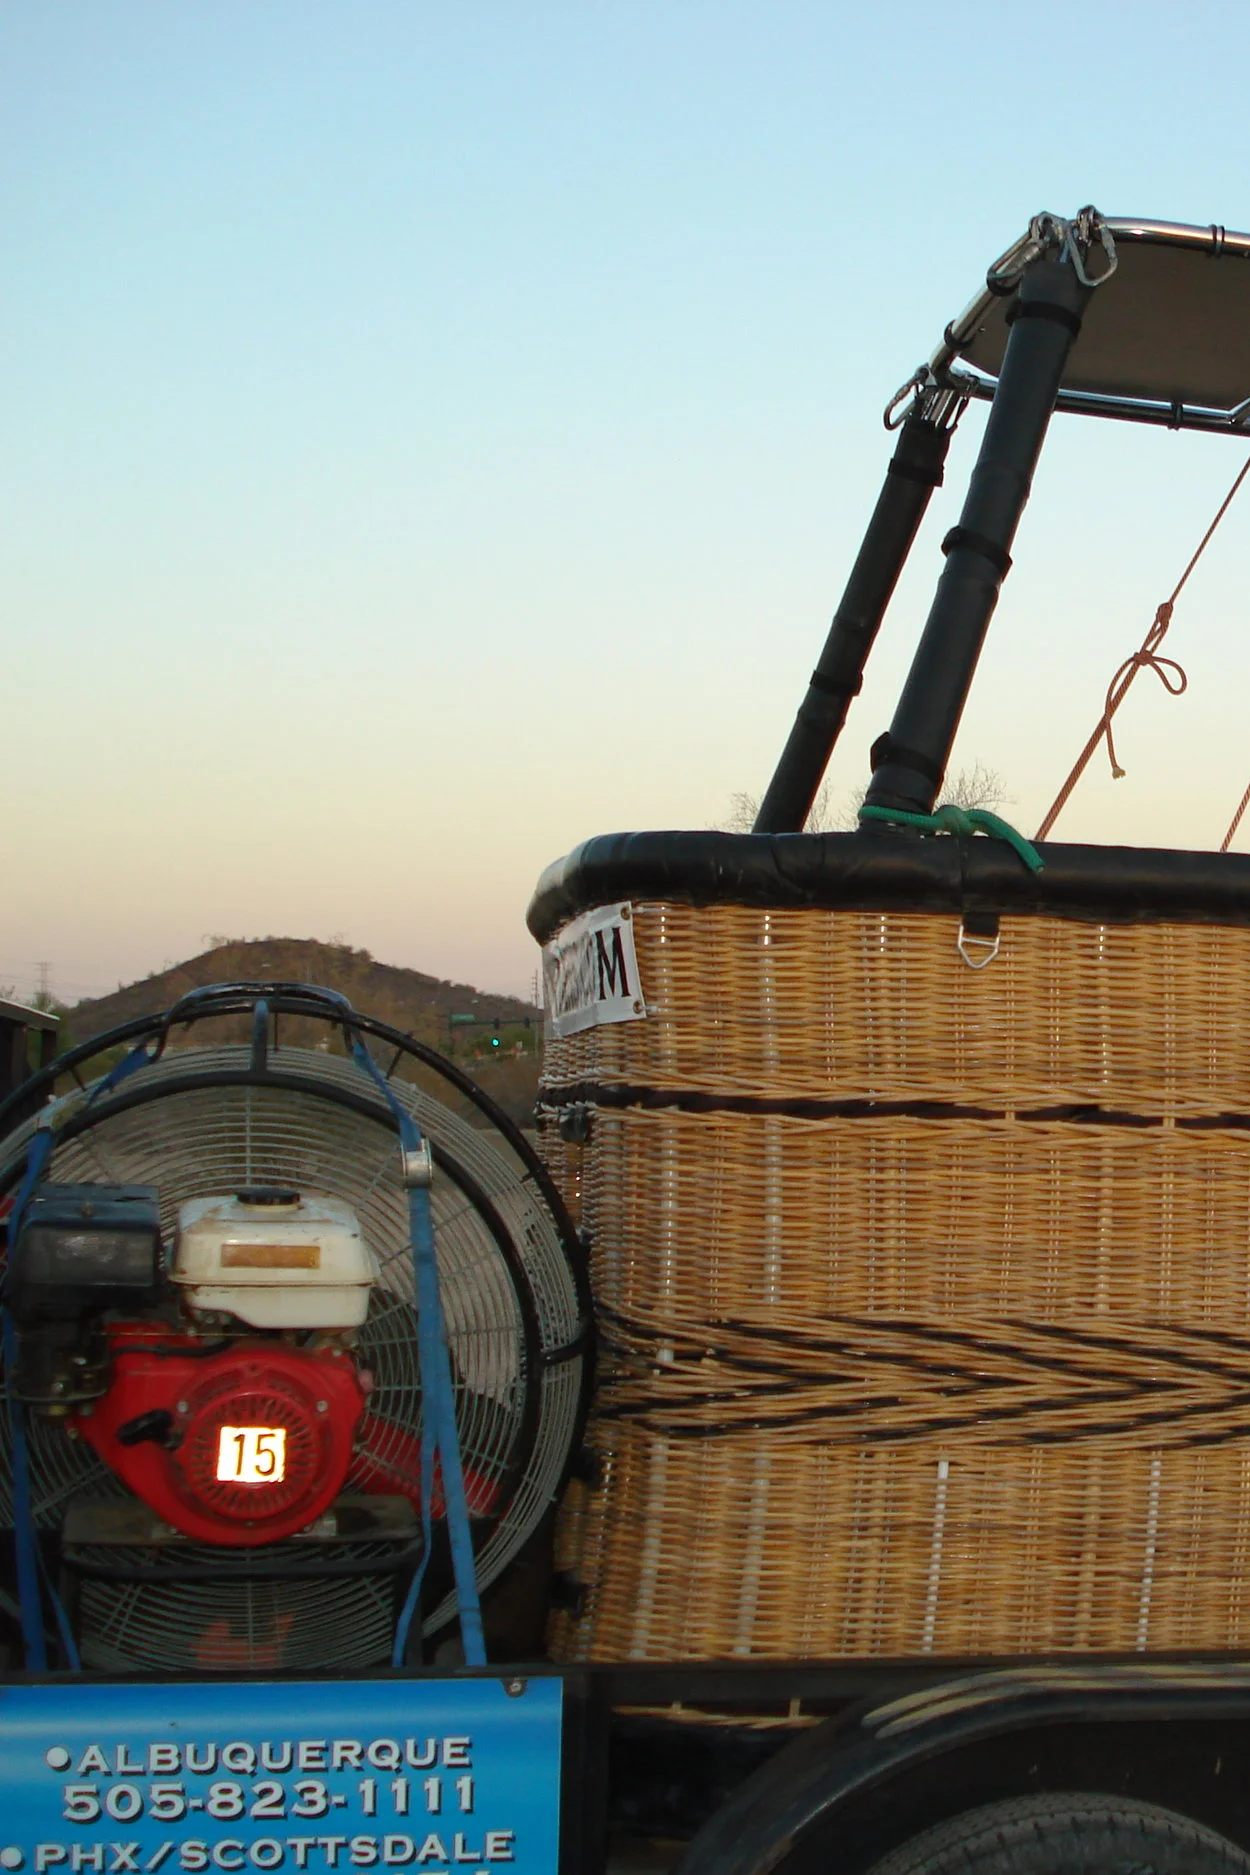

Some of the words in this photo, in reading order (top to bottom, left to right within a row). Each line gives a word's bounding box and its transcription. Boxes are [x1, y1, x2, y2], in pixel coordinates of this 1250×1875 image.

[232, 1433, 276, 1476] 15
[76, 1736, 472, 1778] ALBUQUERQUE
[62, 1775, 474, 1823] 505-823-1111
[35, 1829, 515, 1874] PHX/SCOTTSDALE
